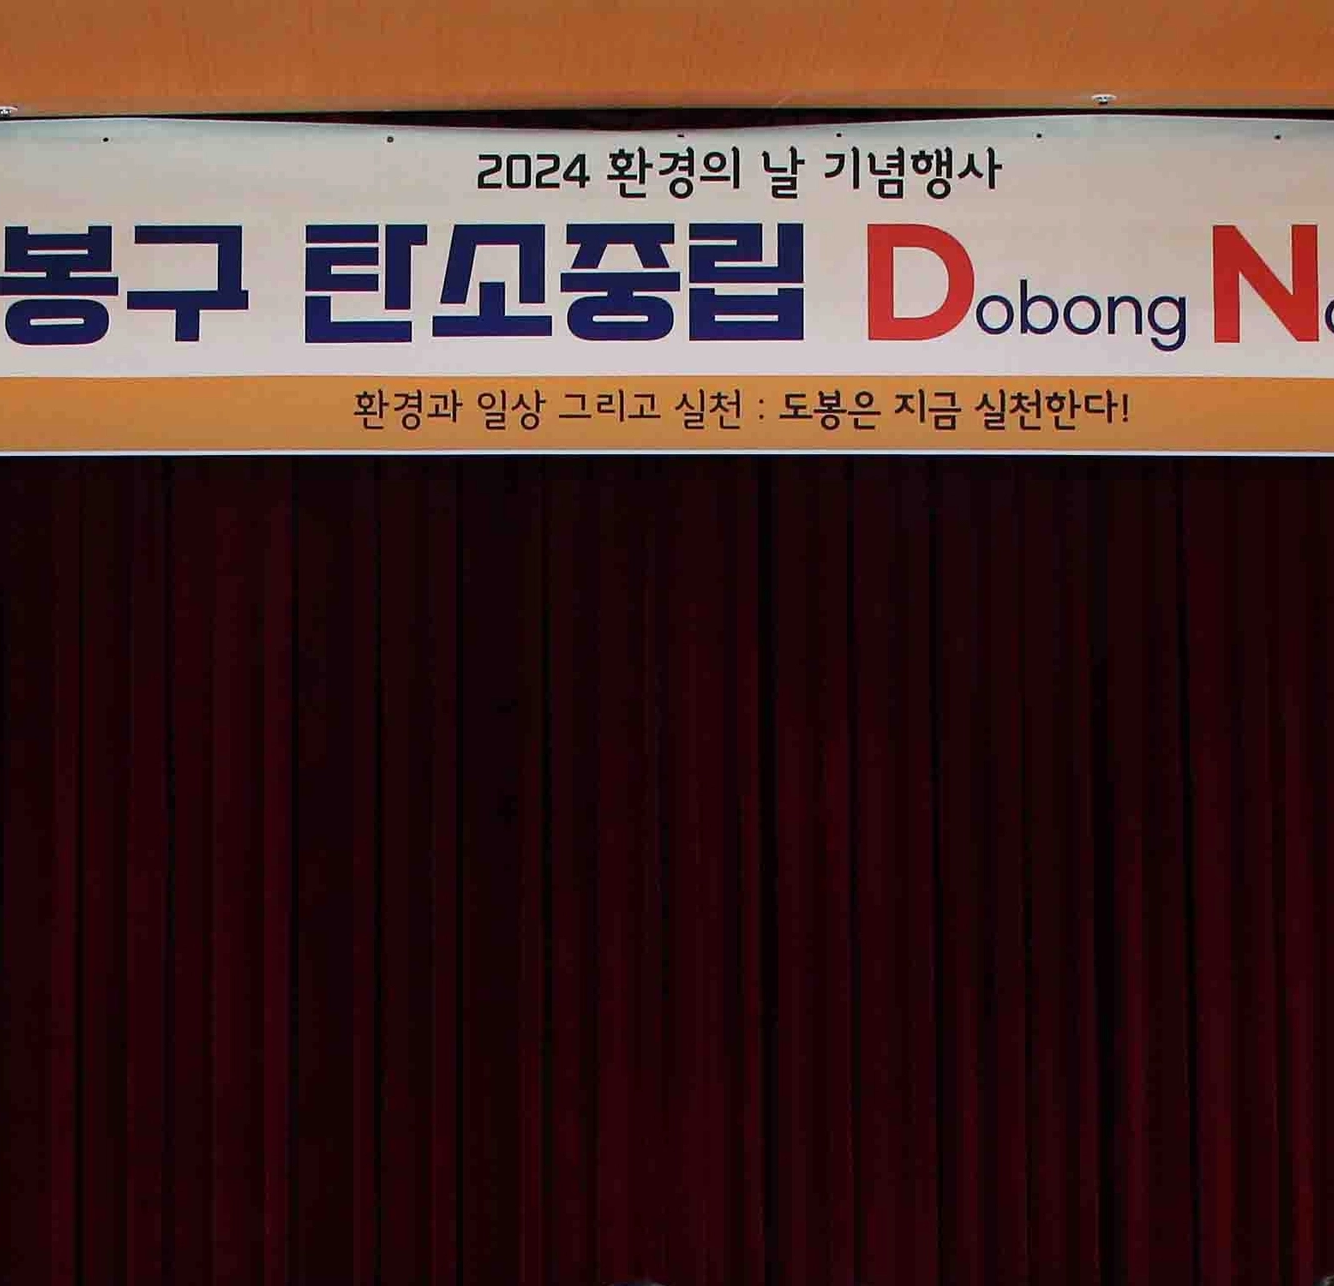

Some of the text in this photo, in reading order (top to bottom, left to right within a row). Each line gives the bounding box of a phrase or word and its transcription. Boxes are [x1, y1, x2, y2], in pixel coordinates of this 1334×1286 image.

[477, 145, 1003, 200] 2024 환경의 날 기념행사
[304, 222, 805, 344] 탄소중립
[867, 223, 1187, 352] Dobong
[353, 388, 1129, 431] 환경과 일상 그리고 실천 도봉은 지금 실천한다!
